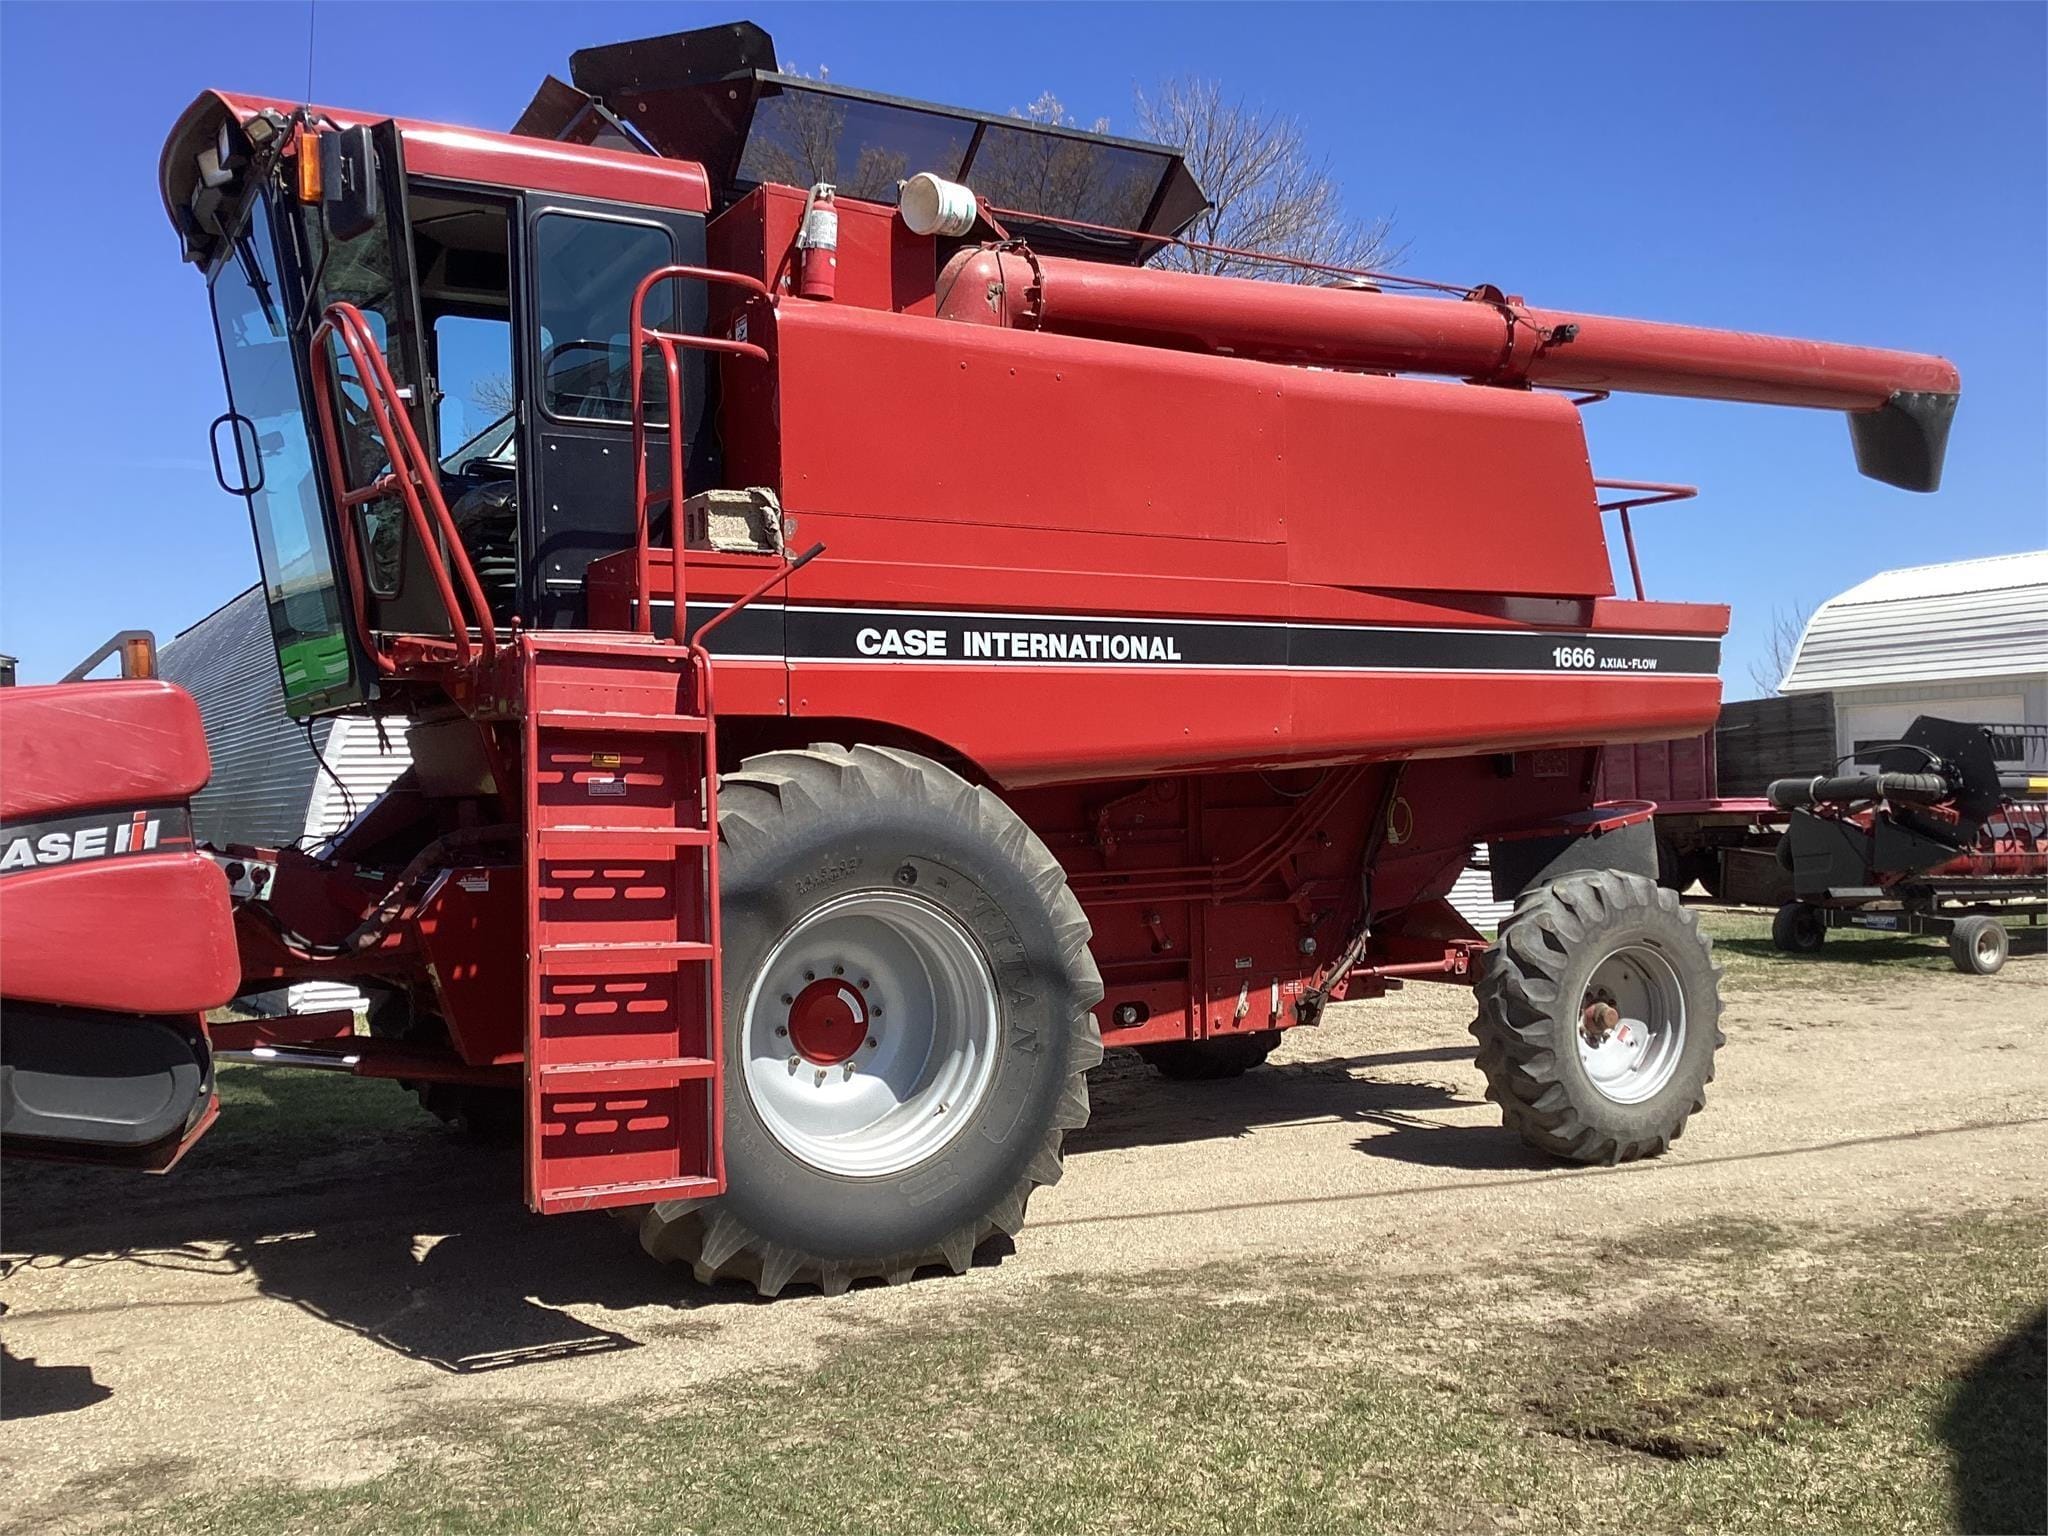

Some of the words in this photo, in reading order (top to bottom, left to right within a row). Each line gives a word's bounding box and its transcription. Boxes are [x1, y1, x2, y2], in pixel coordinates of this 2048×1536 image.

[855, 627, 948, 657] CASE
[963, 630, 1182, 661] INTERNATIONAL
[1552, 646, 1596, 669] 1666
[0, 826, 109, 871] ASE
